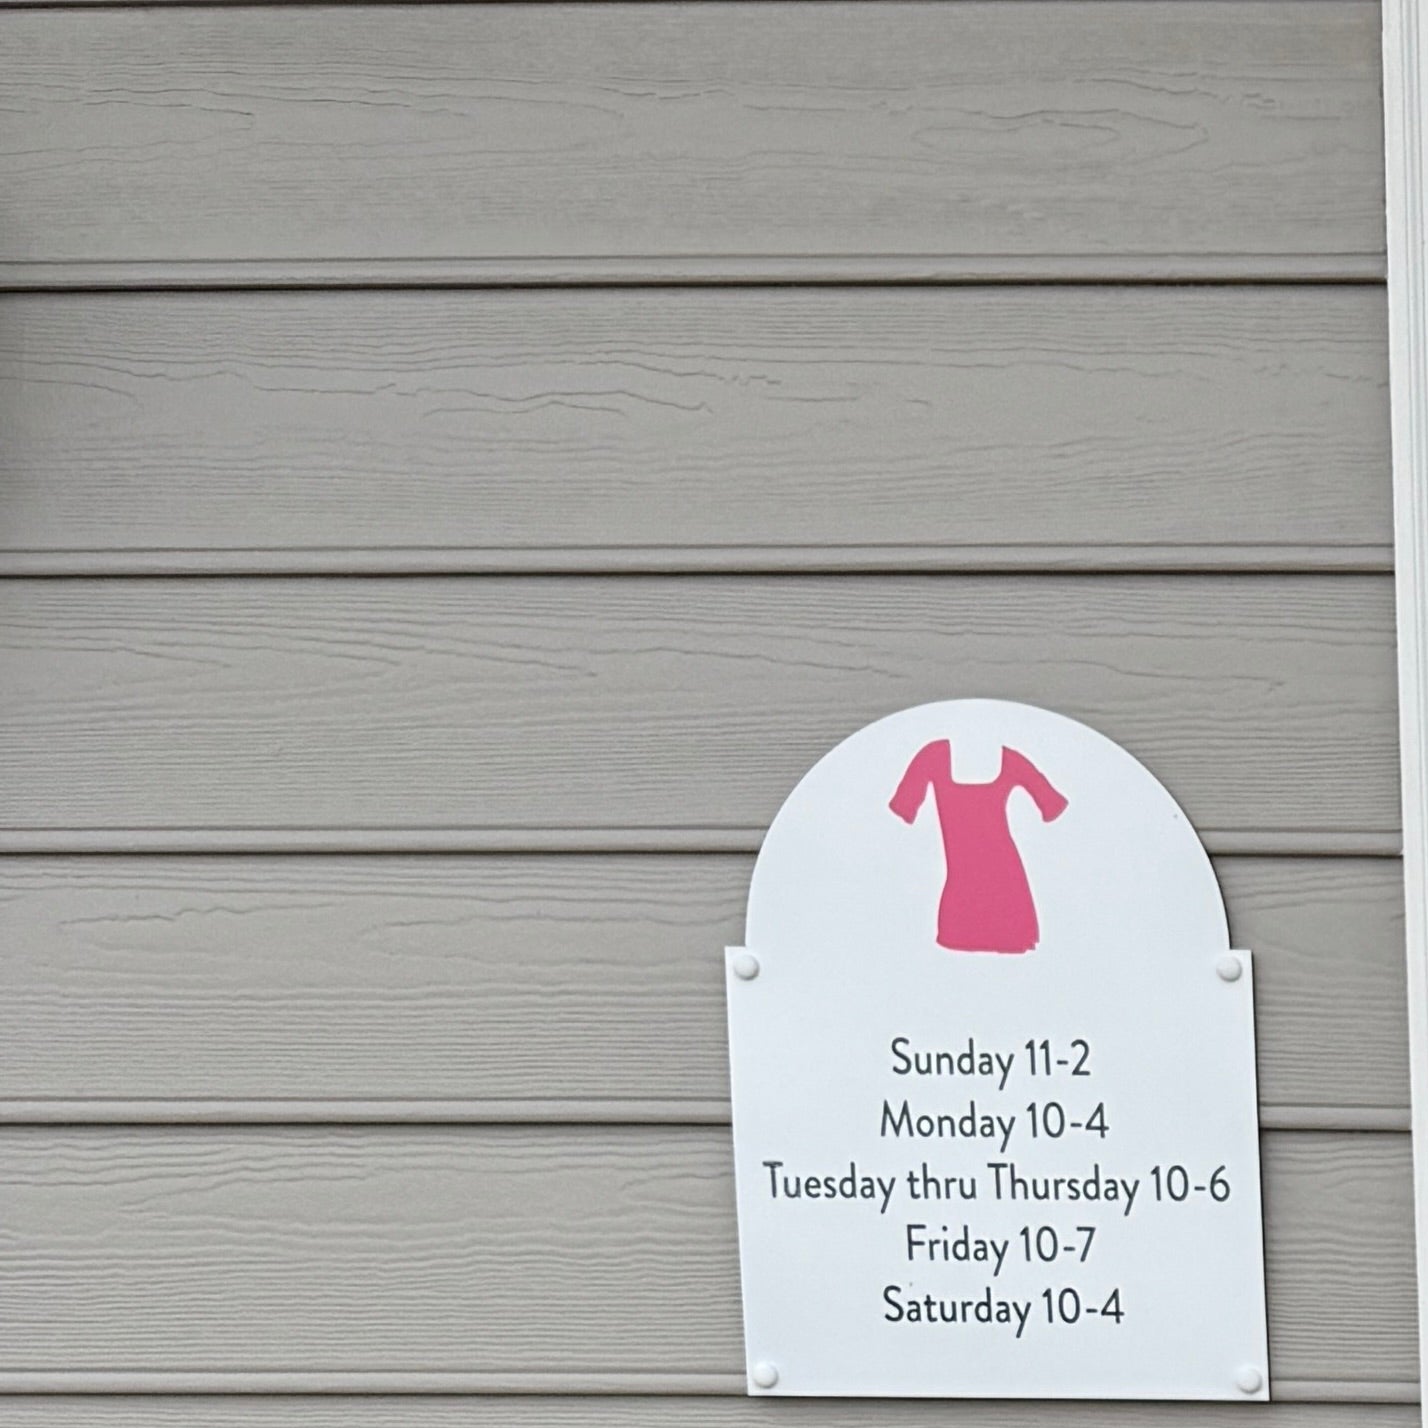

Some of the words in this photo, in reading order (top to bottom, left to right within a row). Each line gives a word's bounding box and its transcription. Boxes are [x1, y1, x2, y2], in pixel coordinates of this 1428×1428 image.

[891, 1036, 1015, 1091] Sunday
[1024, 1038, 1092, 1077] 11-2
[879, 1099, 1016, 1154] Monday
[1025, 1101, 1111, 1140] 10-4
[762, 1160, 896, 1215] Tuesday
[906, 1162, 978, 1201] thru
[986, 1162, 1140, 1217] Thursday
[1149, 1164, 1232, 1203] 10-6
[905, 1223, 1010, 1277] Friday
[1018, 1225, 1097, 1264] 10-7
[882, 1284, 1033, 1339] Saturday
[1041, 1287, 1126, 1325] 10-4
